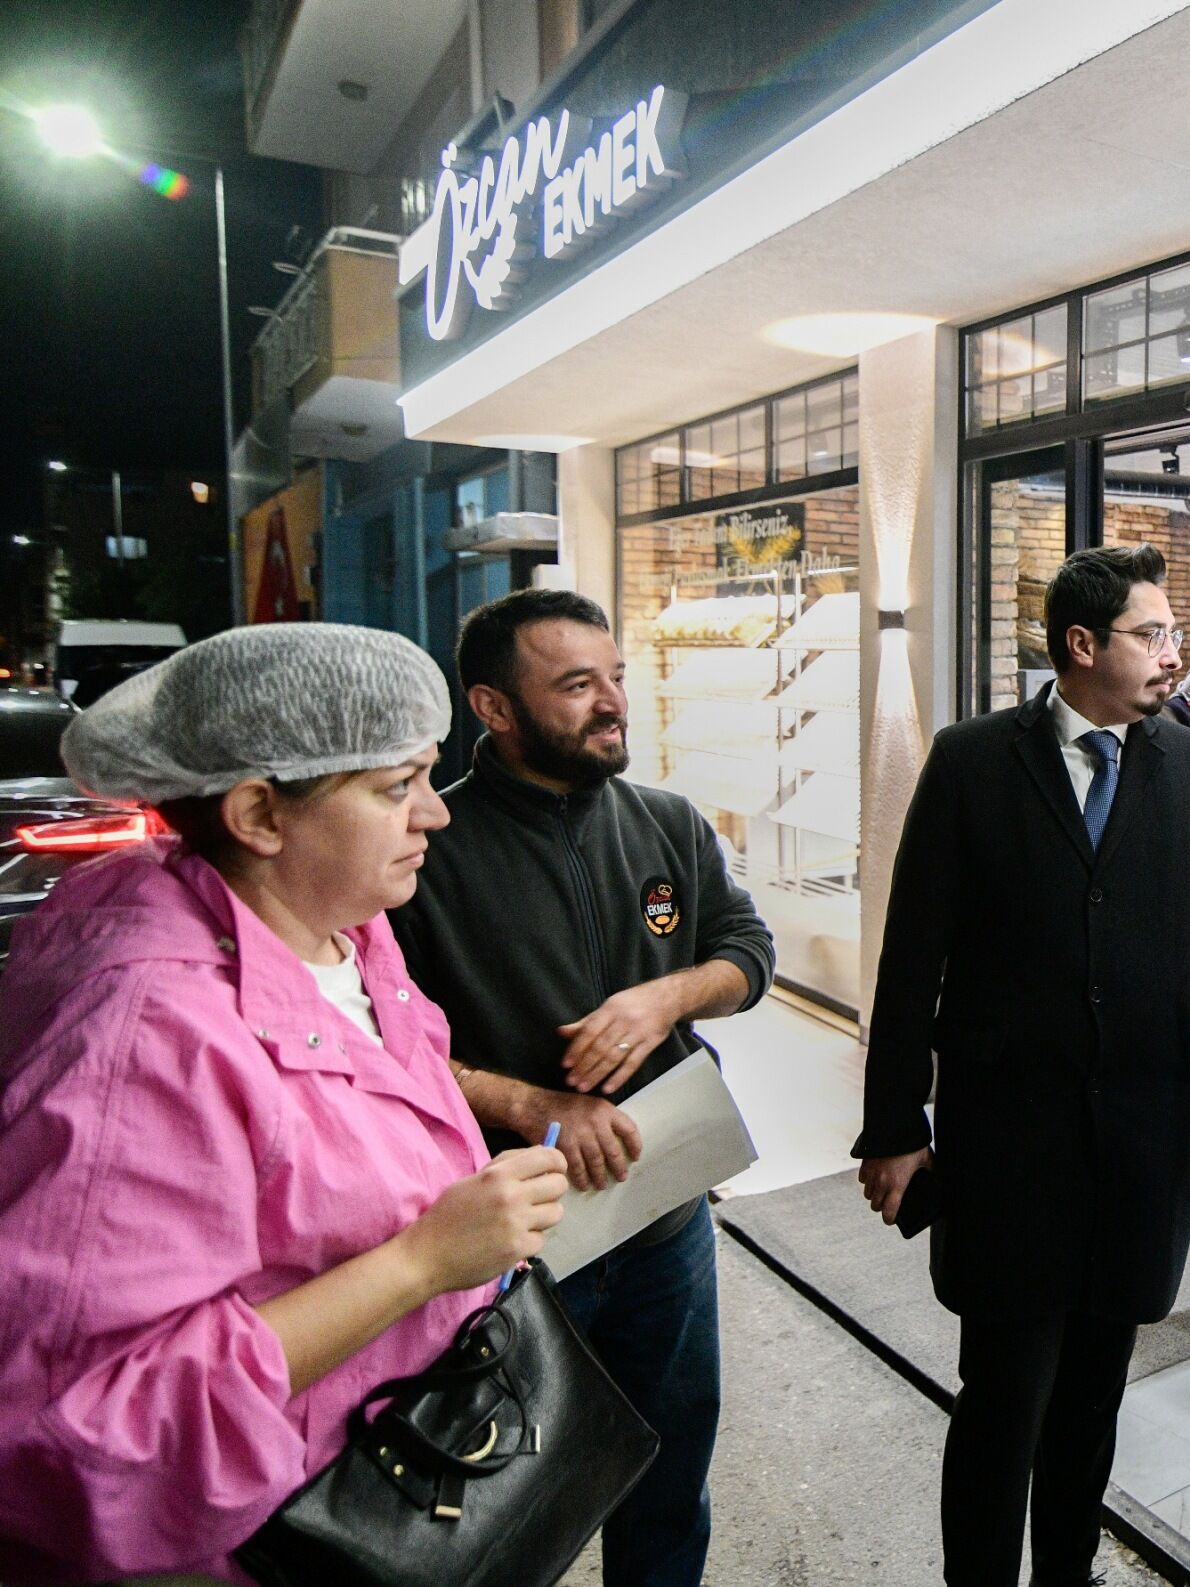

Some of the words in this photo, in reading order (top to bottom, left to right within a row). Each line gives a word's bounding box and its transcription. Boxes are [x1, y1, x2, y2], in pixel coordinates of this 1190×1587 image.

[426, 108, 570, 341] Özcan
[544, 84, 665, 259] EKMEK
[647, 902, 673, 916] EKMEK
